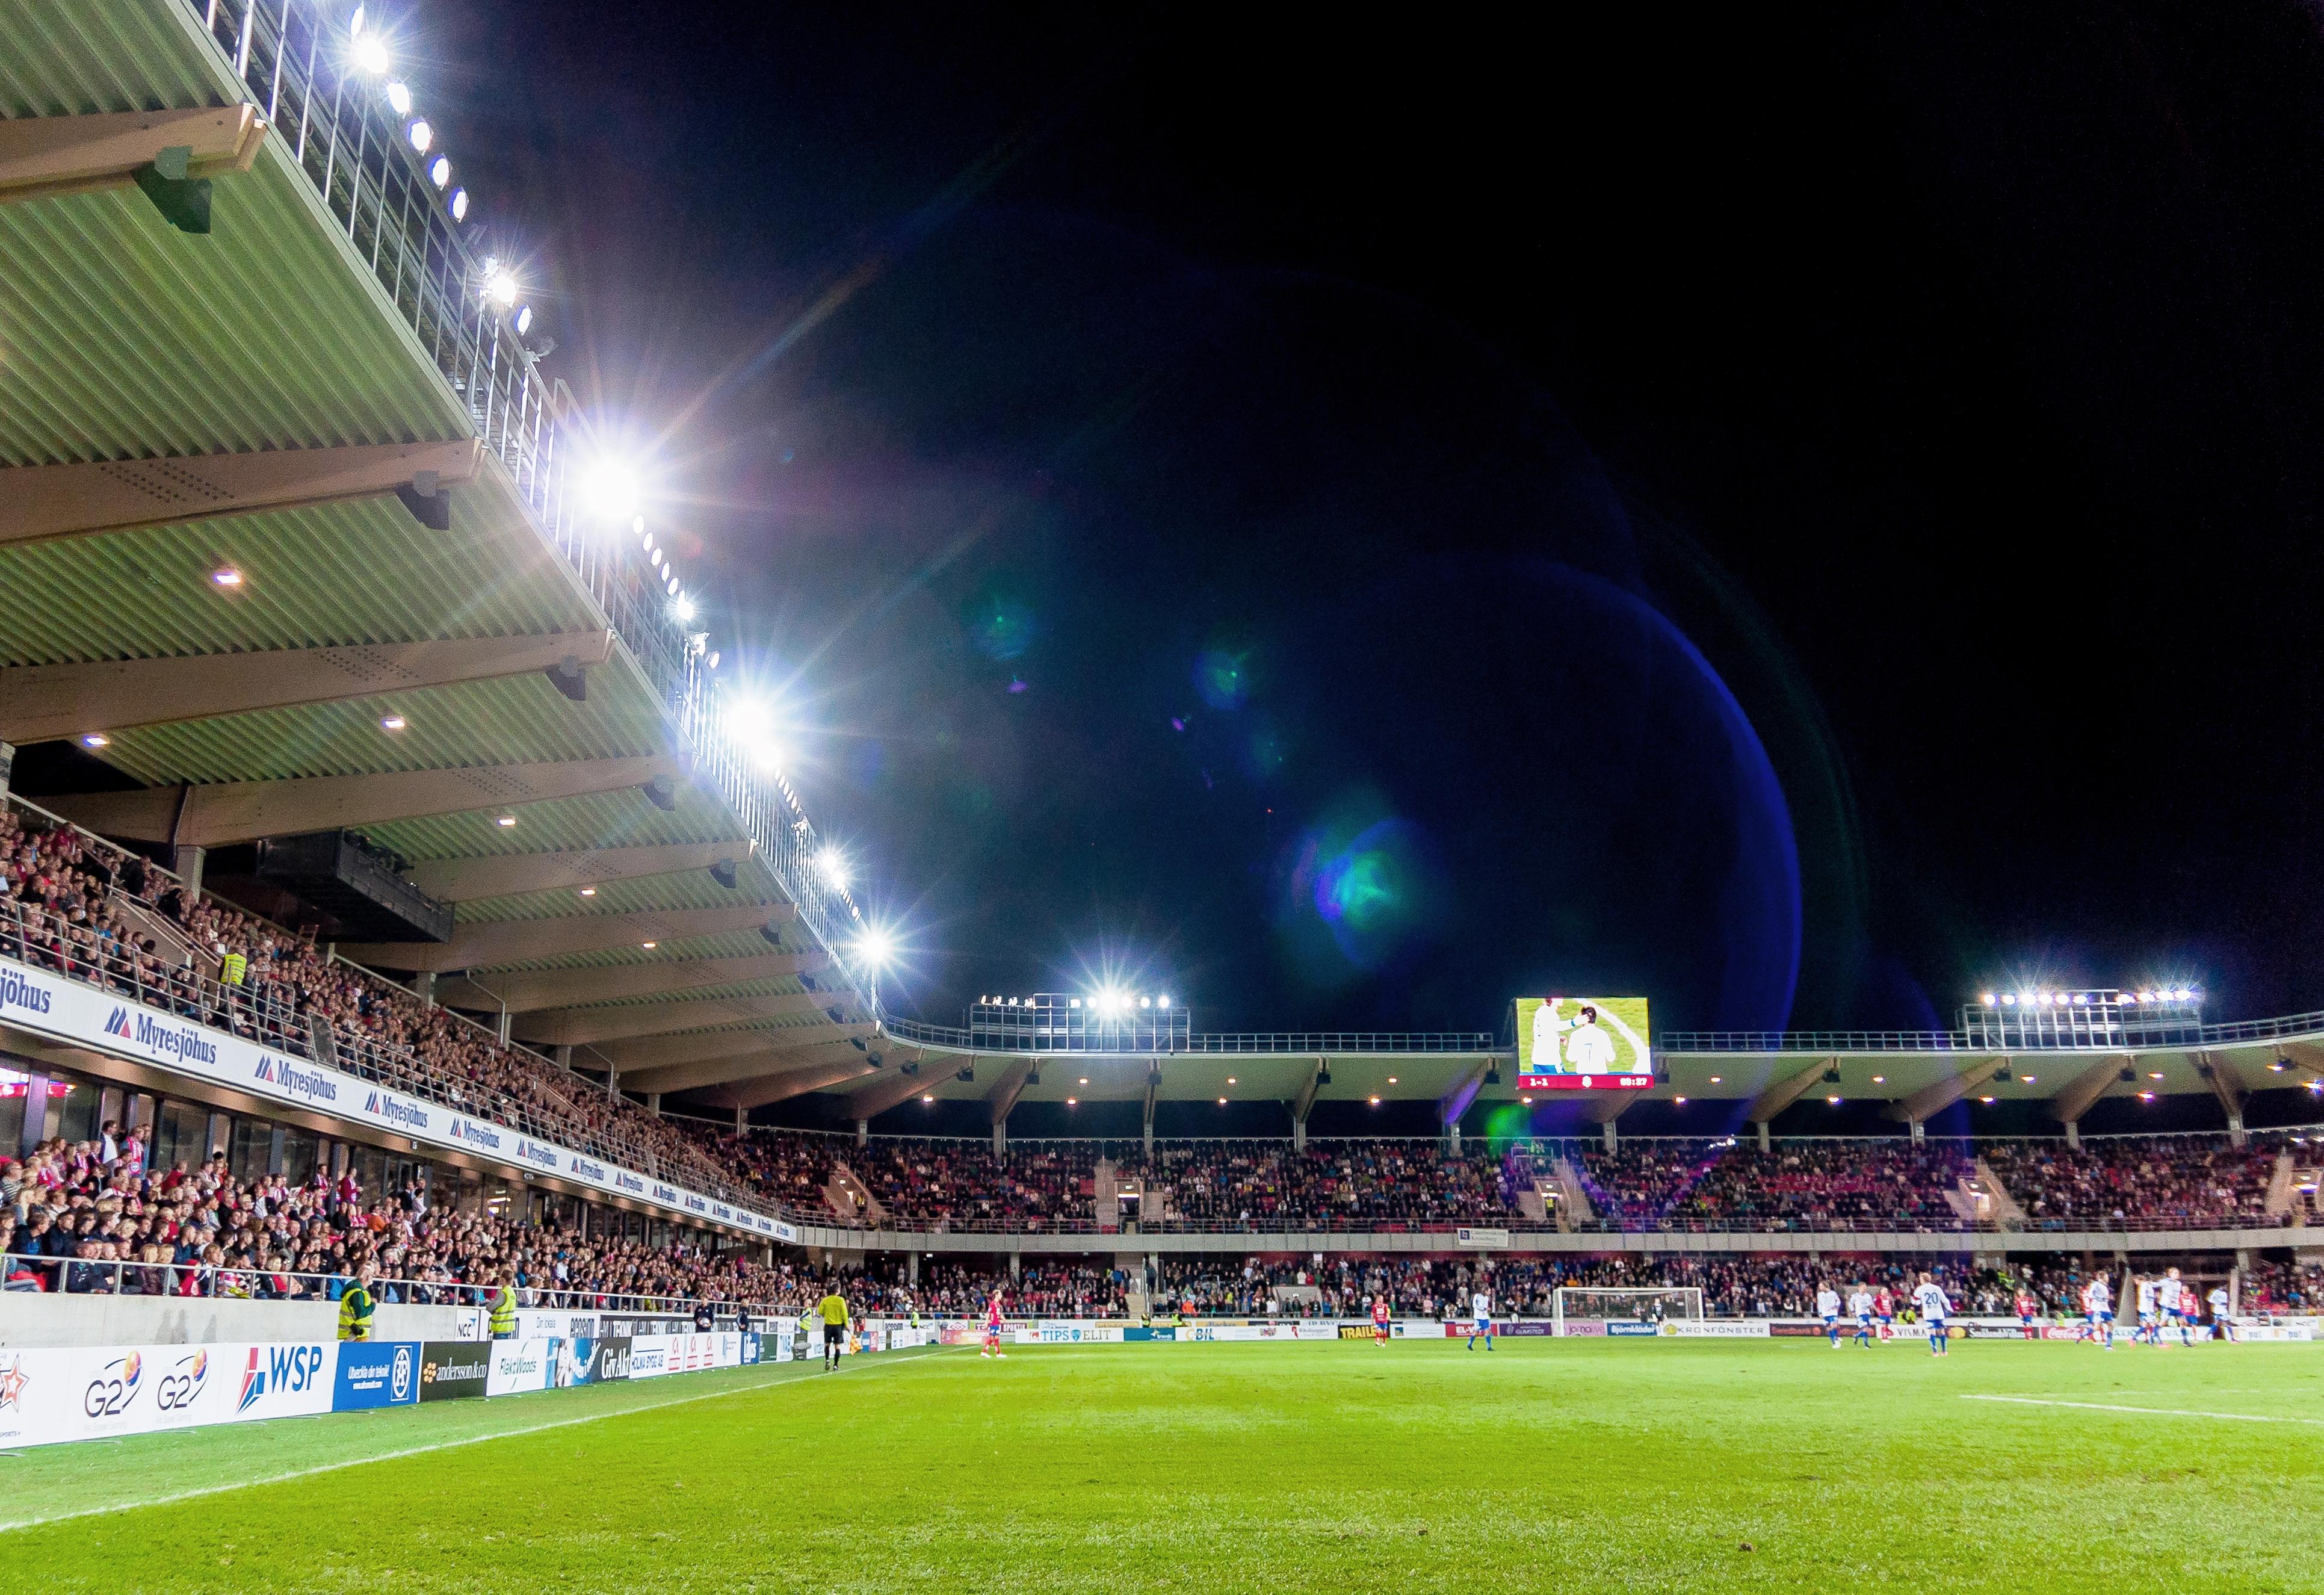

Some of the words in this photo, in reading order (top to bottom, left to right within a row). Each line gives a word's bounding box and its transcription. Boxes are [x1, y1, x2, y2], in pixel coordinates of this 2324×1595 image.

[136, 1013, 217, 1064] Myresjöhus
[277, 1060, 336, 1101] Myresjöhus
[382, 1095, 428, 1129] Myresjöhus
[463, 1121, 499, 1149] Myresjöhus
[527, 1142, 557, 1168] Myresjöhus
[579, 1159, 604, 1182] Myresjöhus
[1924, 1292, 1938, 1304] 20
[457, 1324, 472, 1337] NCC
[1041, 1330, 1069, 1341] TIPS
[1083, 1330, 1111, 1341] ELIT
[1897, 1328, 1927, 1337] VISMA
[270, 1345, 322, 1393] WSP
[436, 1357, 487, 1381] andersson&co
[499, 1357, 537, 1377] FläktWoods
[601, 1347, 631, 1379] GivAkt
[85, 1379, 122, 1418] G2
[157, 1375, 190, 1411] G2
